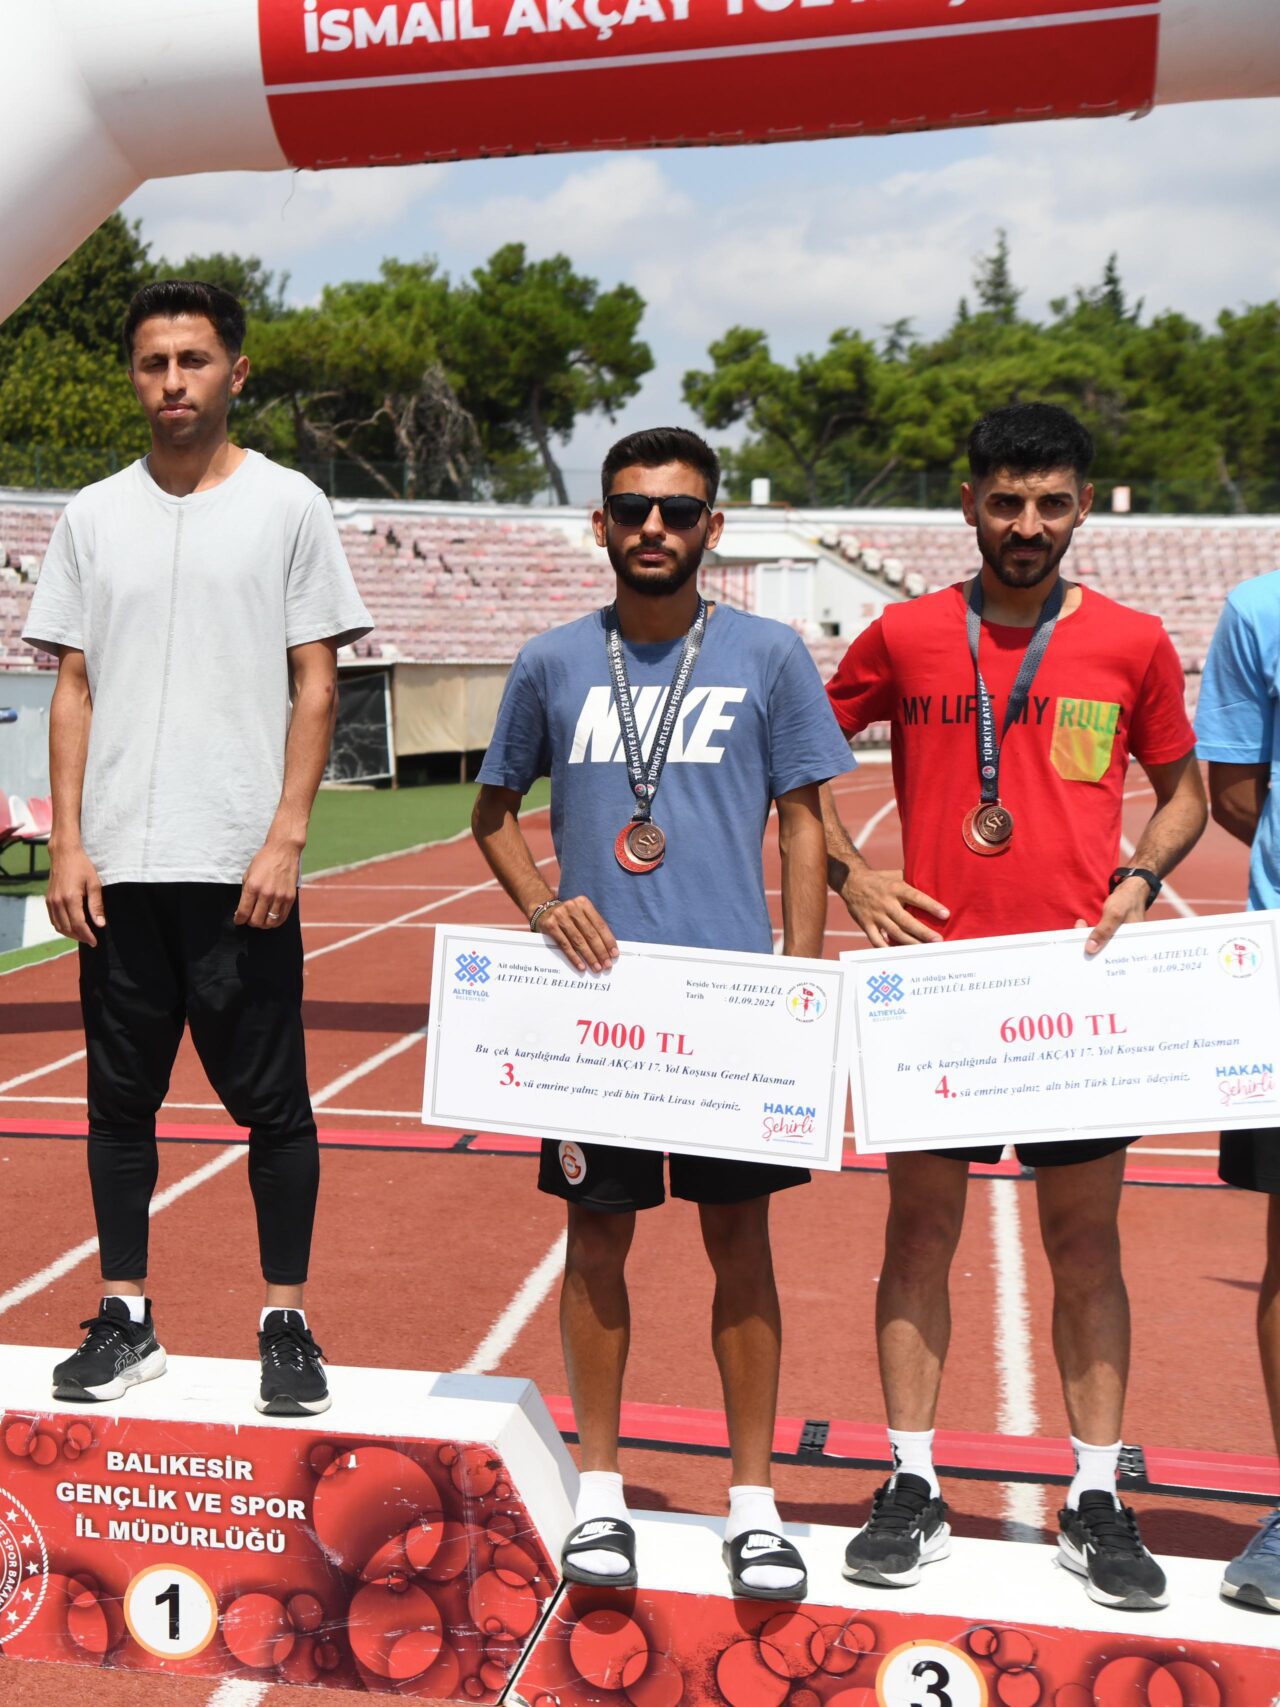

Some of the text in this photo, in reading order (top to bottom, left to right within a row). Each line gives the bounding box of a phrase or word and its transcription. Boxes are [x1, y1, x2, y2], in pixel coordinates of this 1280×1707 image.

[611, 629, 626, 691] FEDERASYONU
[568, 686, 747, 764] NIKE
[648, 646, 696, 781] TÜRKİYE ATLETİZM FEDERASYONU
[902, 696, 932, 725] MY
[941, 695, 995, 724] LIF
[452, 987, 490, 998] ALTIEYLÜL
[495, 974, 612, 993] ALTIEYLÜL BELEDİYESİ
[685, 991, 705, 1000] Tarih
[729, 983, 784, 996] ALTIEYLÜL
[911, 977, 1031, 997] ALTIEYLÜL BELEDİYESİ
[728, 995, 775, 1008] 01.09.2024
[576, 1019, 695, 1056] 7000 TL
[1000, 1012, 1128, 1044] 6000 TL
[475, 1044, 796, 1086] Bu çek karşılığında İsmail AKÇAY 17. Yol Koşusu Genel Klasman
[897, 1062, 911, 1072] Bu
[916, 1060, 933, 1072] çek
[938, 1055, 998, 1069] karşılığında
[1003, 1051, 1035, 1064] İsmail
[1037, 1048, 1077, 1062] AKÇAY
[1097, 1045, 1114, 1056] Yol
[1117, 1044, 1155, 1055] Koşusu
[1158, 1039, 1189, 1052] Genel
[1192, 1037, 1241, 1049] Klasman
[1215, 1062, 1274, 1078] HAKAN
[499, 1062, 521, 1087] 3.
[523, 1080, 534, 1089] sü
[536, 1082, 569, 1093] emrine
[570, 1085, 599, 1097] yalnız
[601, 1089, 623, 1099] yedi
[624, 1091, 640, 1100] bin
[643, 1091, 665, 1103] Türk
[667, 1094, 696, 1106] Lirası
[934, 1075, 957, 1099] 4.
[960, 1088, 971, 1098] sü
[974, 1086, 1009, 1097] emrine
[1064, 1080, 1081, 1090] bin
[1084, 1077, 1108, 1089] Türk
[1111, 1075, 1141, 1087] Lirası
[763, 1102, 816, 1118] HAKAN
[762, 1115, 815, 1142] Şehirli
[106, 1450, 254, 1481] BALIKESİR
[56, 1481, 307, 1520] GENÇLİK VE SPOR
[75, 1513, 286, 1554] İL MÜDÜRLÜĞÜ
[581, 1520, 618, 1535] NIKE
[747, 1533, 782, 1549] NIKE
[2, 1538, 18, 1569] SPOR
[155, 1583, 180, 1641] 1
[910, 1660, 950, 1707] 3
